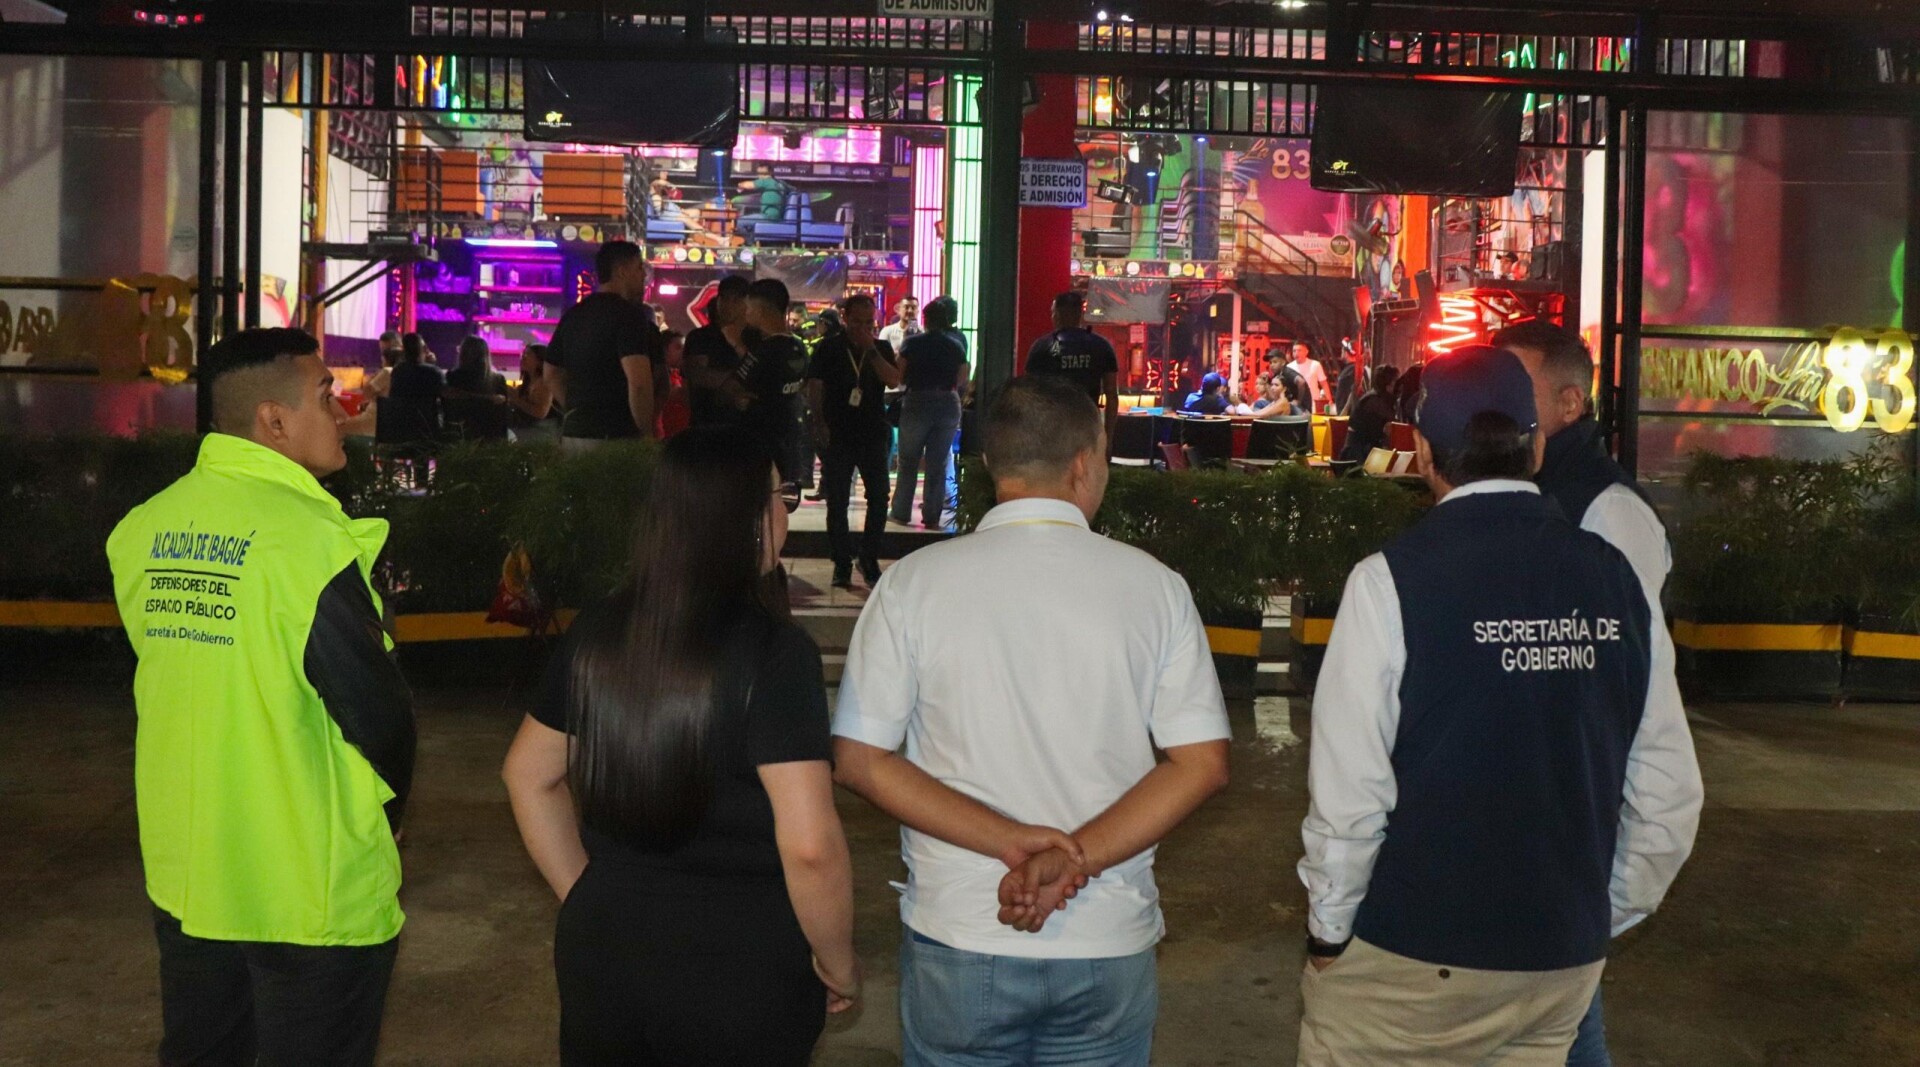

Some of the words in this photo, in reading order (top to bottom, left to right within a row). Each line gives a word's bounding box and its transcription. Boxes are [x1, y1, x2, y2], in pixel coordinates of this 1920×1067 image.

[884, 0, 904, 9] DE
[1032, 163, 1082, 174] RESERVAMOS
[1272, 148, 1311, 180] 83
[1030, 174, 1081, 187] DERECHO
[1029, 188, 1082, 203] ADMISIÓN
[1641, 347, 1767, 402] ESTANCO
[1820, 325, 1916, 434] 83
[150, 520, 194, 560] ALCALDÍA
[193, 533, 210, 560] DE
[206, 529, 257, 567] IBAGUÉ
[150, 576, 208, 593] DEFENSORES
[208, 580, 232, 597] DEL
[145, 598, 182, 614] ESPACIO
[185, 596, 236, 621] PÚBLICO
[1473, 608, 1592, 643] SECRETARÍA
[1596, 617, 1620, 641] DE
[1501, 645, 1596, 672] GOBIERNO
